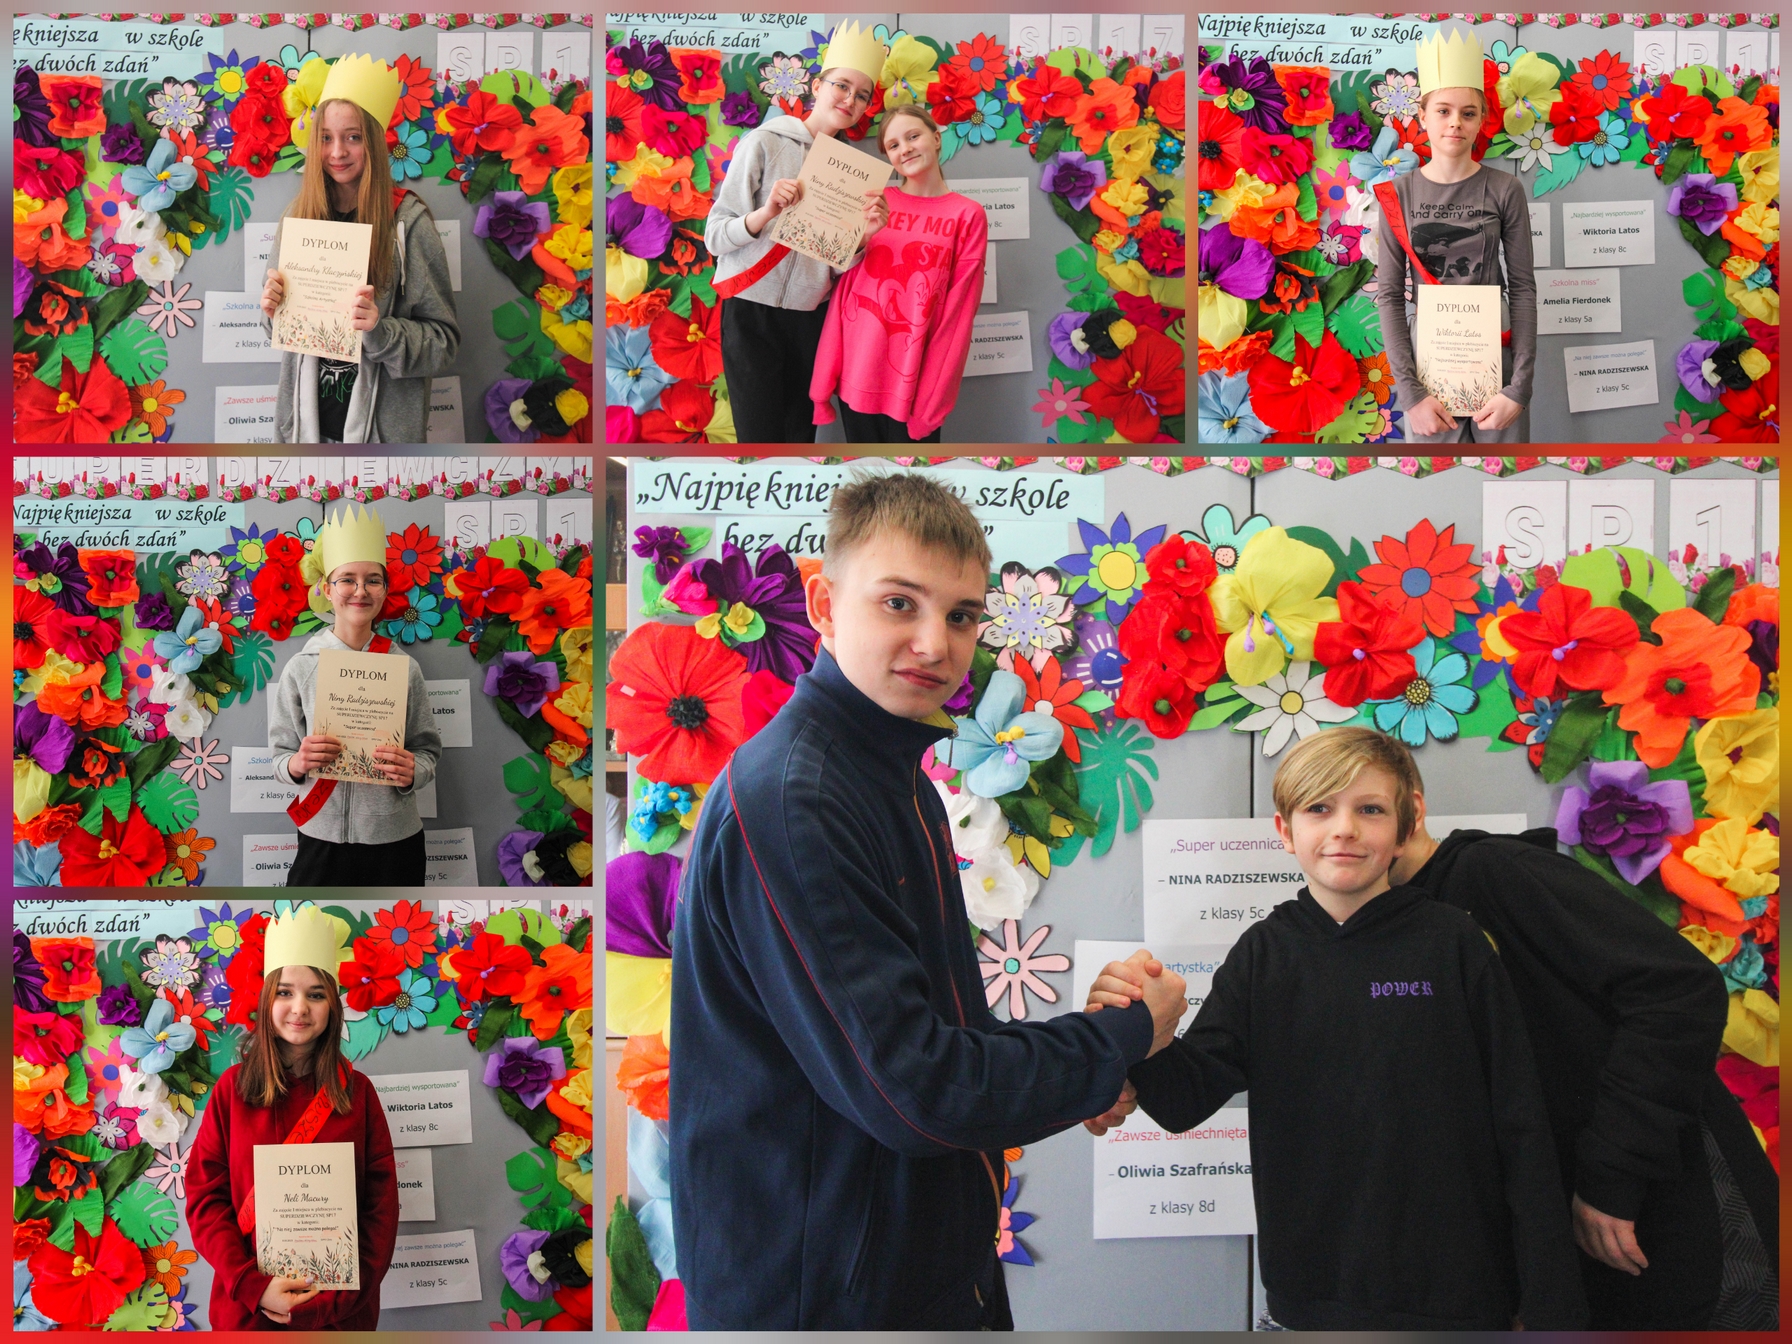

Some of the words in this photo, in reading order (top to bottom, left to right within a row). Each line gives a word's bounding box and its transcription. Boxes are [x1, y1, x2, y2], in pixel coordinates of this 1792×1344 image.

[125, 31, 143, 44] w
[148, 28, 204, 50] szkole
[662, 29, 715, 47] dwóch
[1350, 25, 1367, 37] w
[1371, 24, 1423, 45] szkole
[1265, 44, 1324, 63] dwóch
[34, 53, 97, 72] dwóch
[827, 156, 870, 182] DYPLOM
[1420, 202, 1445, 211] Keep
[1447, 203, 1474, 211] Calm
[1411, 210, 1430, 219] And
[1433, 211, 1464, 219] carry
[1467, 209, 1482, 217] on
[301, 237, 349, 251] DYPLOM
[1598, 246, 1617, 254] klasy
[1572, 296, 1611, 304] Fierdonek
[1436, 303, 1480, 313] DYPLOM
[1564, 316, 1581, 324] klasy
[241, 339, 261, 350] klasy
[974, 334, 1024, 344] RADZISZEWSKA
[978, 353, 996, 362] klasy
[1597, 365, 1649, 374] RADZISZEWSKA
[1601, 384, 1619, 393] klasy
[228, 416, 257, 425] Oliwia
[975, 476, 1070, 516] szkole
[155, 507, 172, 521] w
[176, 505, 227, 525] szkole
[75, 529, 130, 547] dwóch
[339, 668, 387, 681] DYPLOM
[328, 692, 345, 704] Niny
[346, 694, 396, 708] Radziszewskiej
[432, 707, 455, 715] Latos
[266, 791, 285, 801] klasy
[286, 791, 296, 799] 6a
[255, 862, 281, 870] Oliwia
[438, 872, 448, 880] 5c
[1169, 874, 1202, 885] NINA
[1205, 872, 1305, 884] RADZISZEWSKA
[1200, 910, 1207, 919] z
[1211, 907, 1245, 921] klasy
[1249, 906, 1265, 919] 5c
[26, 914, 88, 935] dwóch
[387, 1103, 426, 1112] Wiktoria
[428, 1101, 454, 1110] Latos
[406, 1123, 427, 1134] klasy
[428, 1123, 439, 1131] 8c
[278, 1164, 331, 1176] DYPLOM
[1117, 1164, 1165, 1178] Oliwia
[1170, 1161, 1252, 1177] Szafrańska
[283, 1193, 300, 1203] Neli
[300, 1193, 329, 1204] Macury
[1150, 1204, 1156, 1214] z
[1161, 1201, 1194, 1216] klasy
[1199, 1199, 1216, 1213] 8d
[389, 1262, 409, 1270] NINA
[410, 1258, 469, 1268] RADZISZEWSKA
[416, 1279, 436, 1289] klasy
[438, 1278, 448, 1286] 5c
